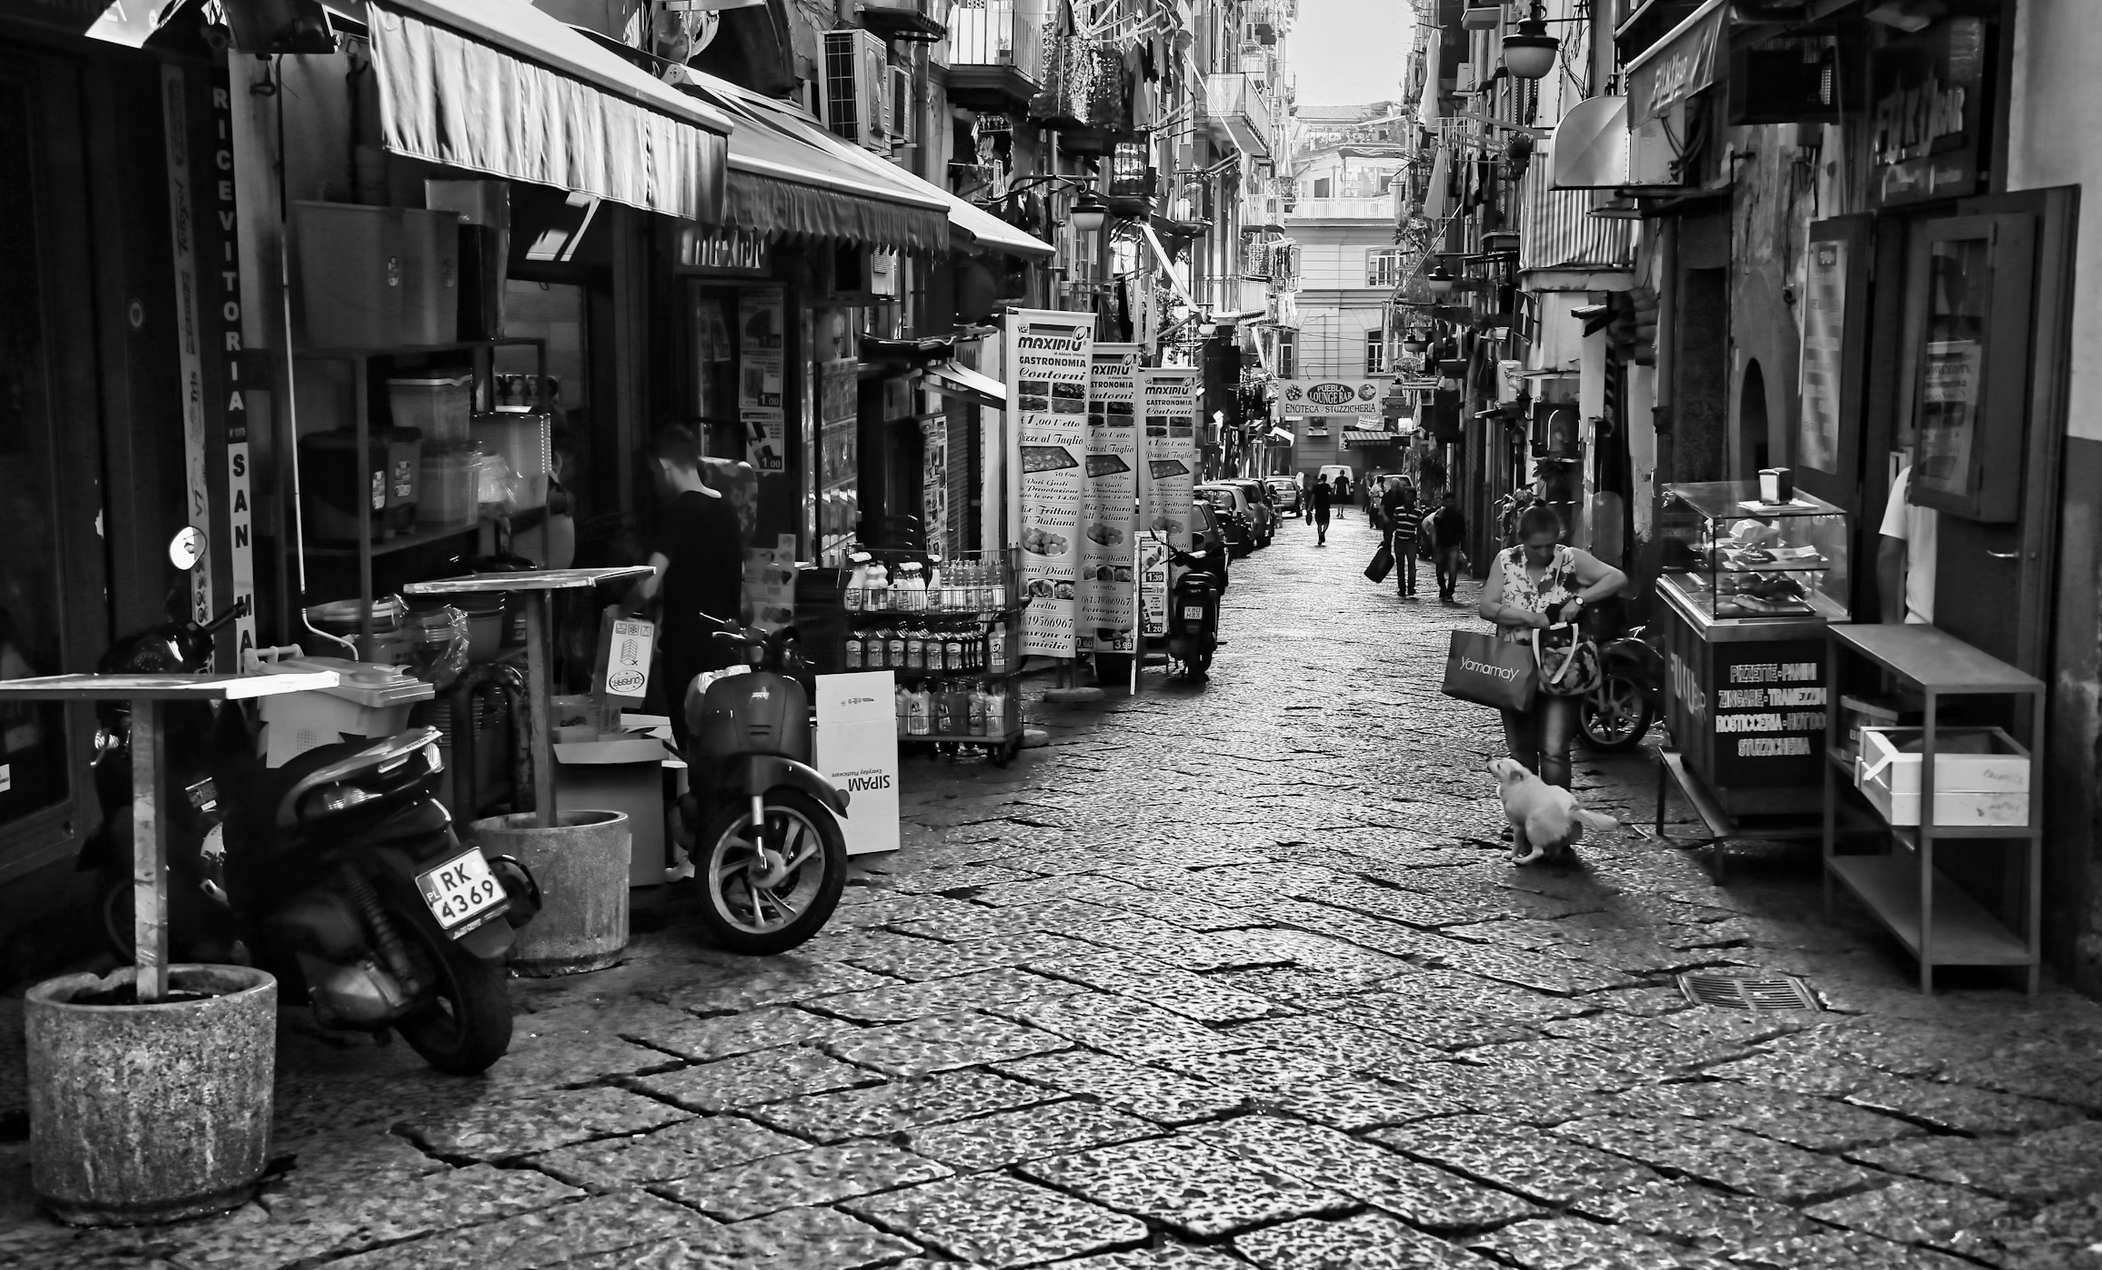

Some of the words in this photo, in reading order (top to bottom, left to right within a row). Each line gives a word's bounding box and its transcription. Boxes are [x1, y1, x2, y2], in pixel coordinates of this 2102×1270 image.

[213, 86, 245, 411] RICEVITORIA
[1019, 356, 1086, 367] GASTRONOMIA
[1019, 367, 1086, 380] Contorni
[1090, 381, 1134, 389] STRONOMIA
[1317, 384, 1344, 392] PUEBLA
[1090, 392, 1134, 400] ontorni
[1310, 391, 1338, 404] LOUNGE
[1339, 391, 1353, 402] BAR
[1146, 407, 1192, 415] Contorni
[1285, 403, 1320, 413] ENOTECA
[1326, 403, 1376, 413] STUZZICHERIA
[1040, 433, 1051, 443] al
[1054, 433, 1084, 446] Taglio
[1110, 443, 1134, 454] Taglio
[1026, 485, 1078, 494] Prenotazione
[233, 454, 252, 548] SAN
[1036, 504, 1078, 516] Frittura
[1034, 515, 1075, 527] Italiana
[1044, 565, 1075, 576] Piatti
[1460, 656, 1520, 682] Yamamay
[1730, 663, 1778, 683] PIZZETTE
[1782, 662, 1817, 681] PANINI
[612, 676, 642, 687] QUASAR
[1718, 689, 1764, 708] ZINGARE
[1767, 687, 1827, 706] TRAMEZZIN
[1715, 713, 1783, 733] ROSTICCERIA
[1738, 737, 1811, 756] STUZZICHERIA
[832, 771, 860, 780] Plasticware
[860, 768, 883, 779] Everyday
[848, 775, 891, 792] SIPAM
[440, 863, 472, 892] RK
[426, 890, 442, 903] PL
[442, 880, 494, 919] 4369
